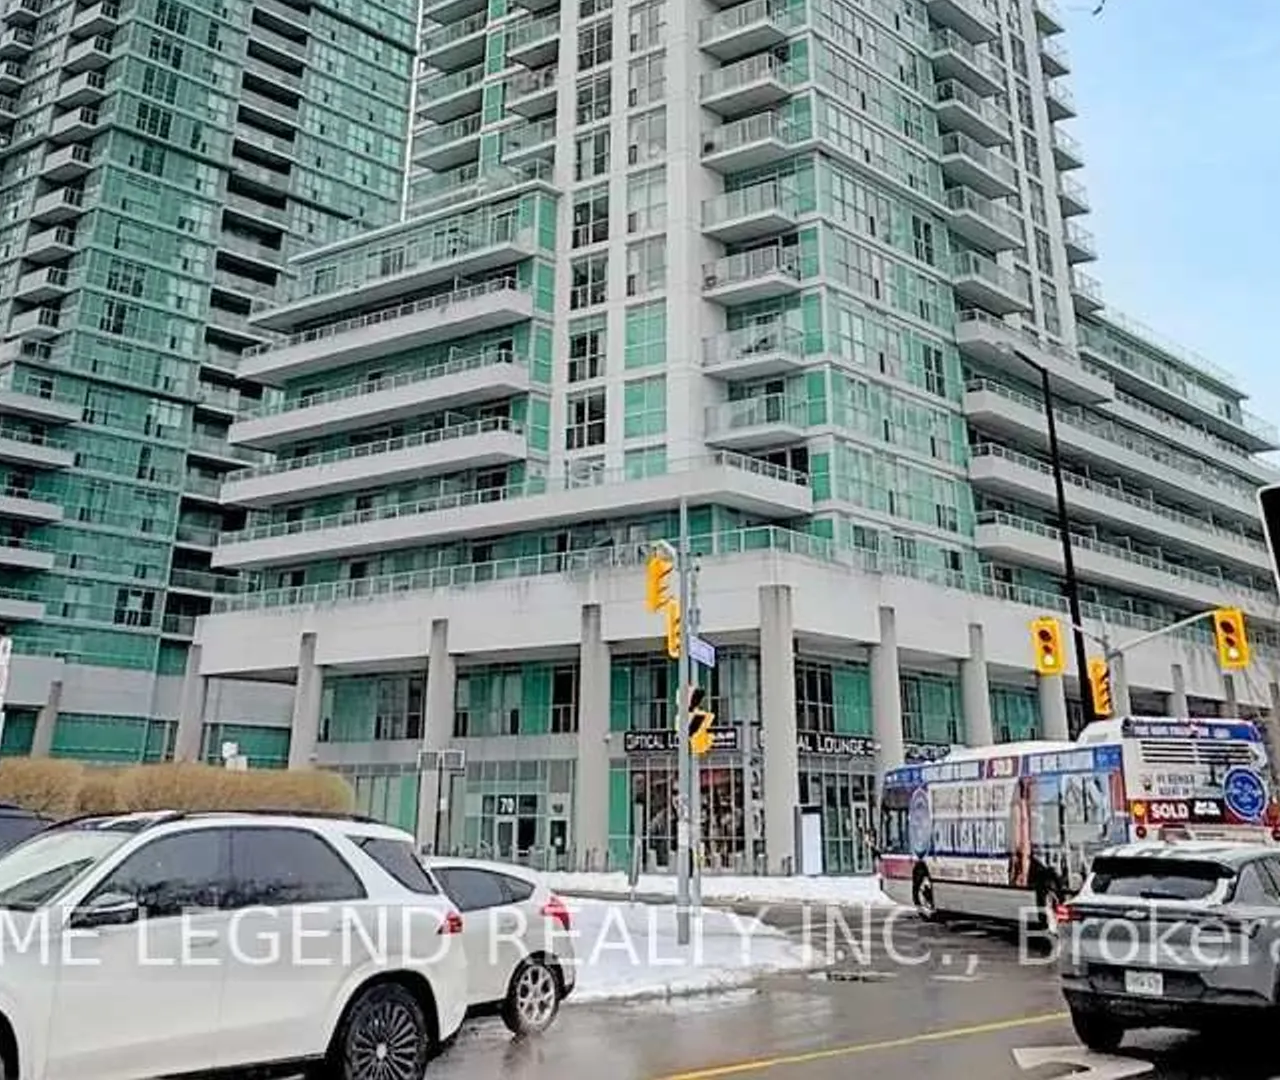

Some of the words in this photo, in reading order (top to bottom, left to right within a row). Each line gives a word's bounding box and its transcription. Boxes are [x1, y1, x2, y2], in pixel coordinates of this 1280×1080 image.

[625, 733, 665, 750] OPTICAL
[817, 734, 865, 755] LOUNGE
[500, 797, 515, 813] 70
[1150, 801, 1189, 820] SOLD
